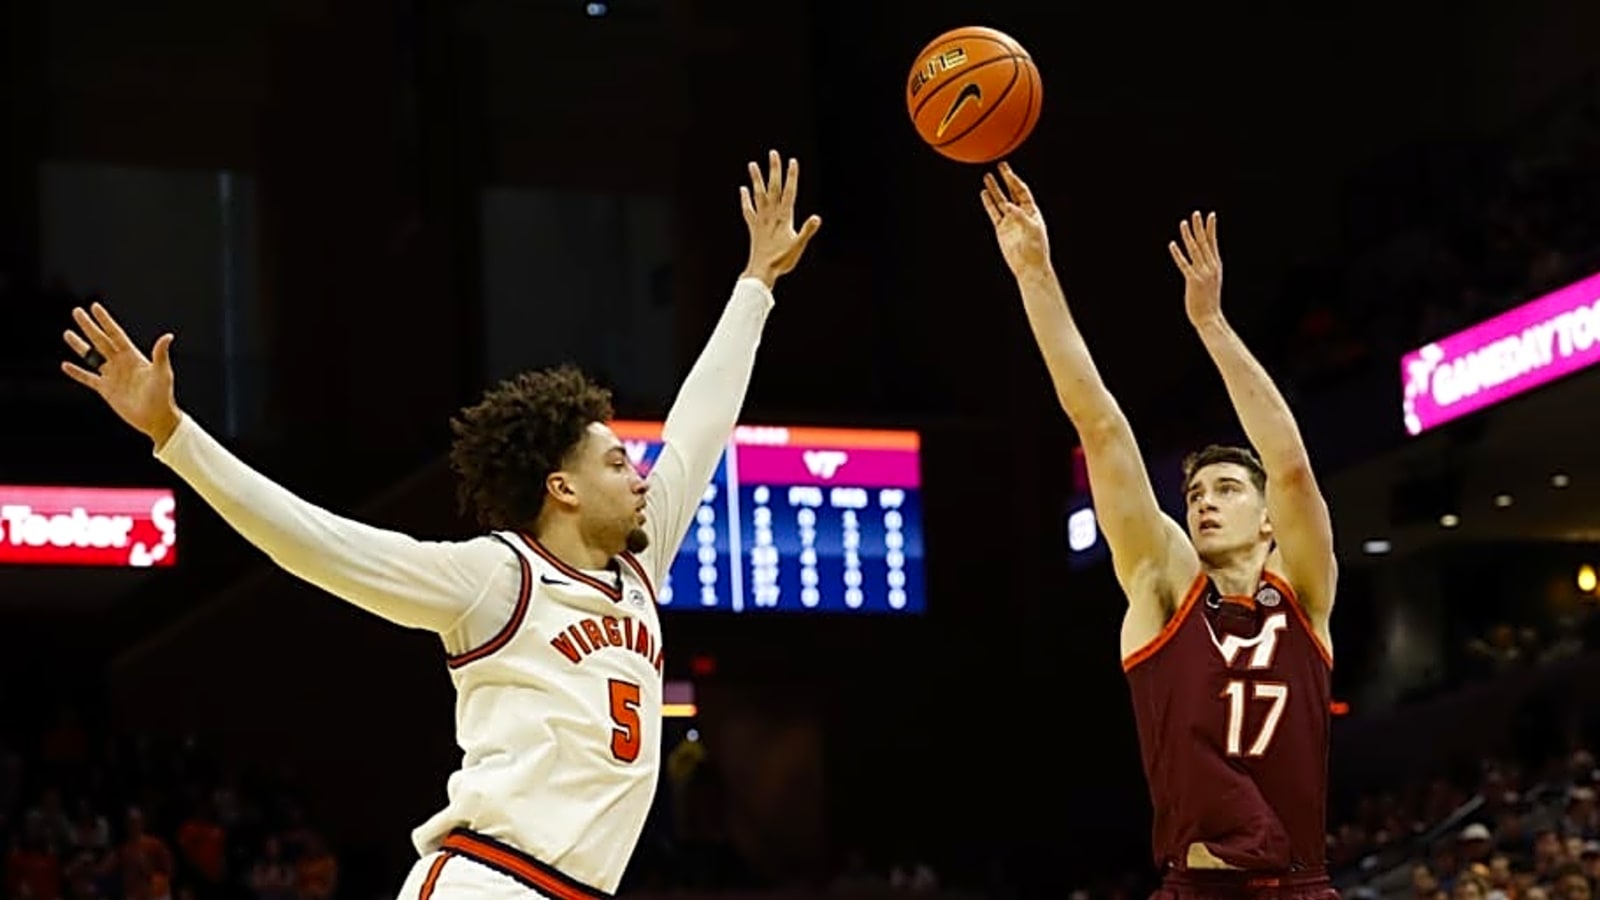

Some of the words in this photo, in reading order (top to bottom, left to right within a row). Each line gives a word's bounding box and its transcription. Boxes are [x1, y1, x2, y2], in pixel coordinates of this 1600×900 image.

[803, 450, 848, 479] VT
[607, 678, 641, 763] 5
[1219, 678, 1289, 758] 17
